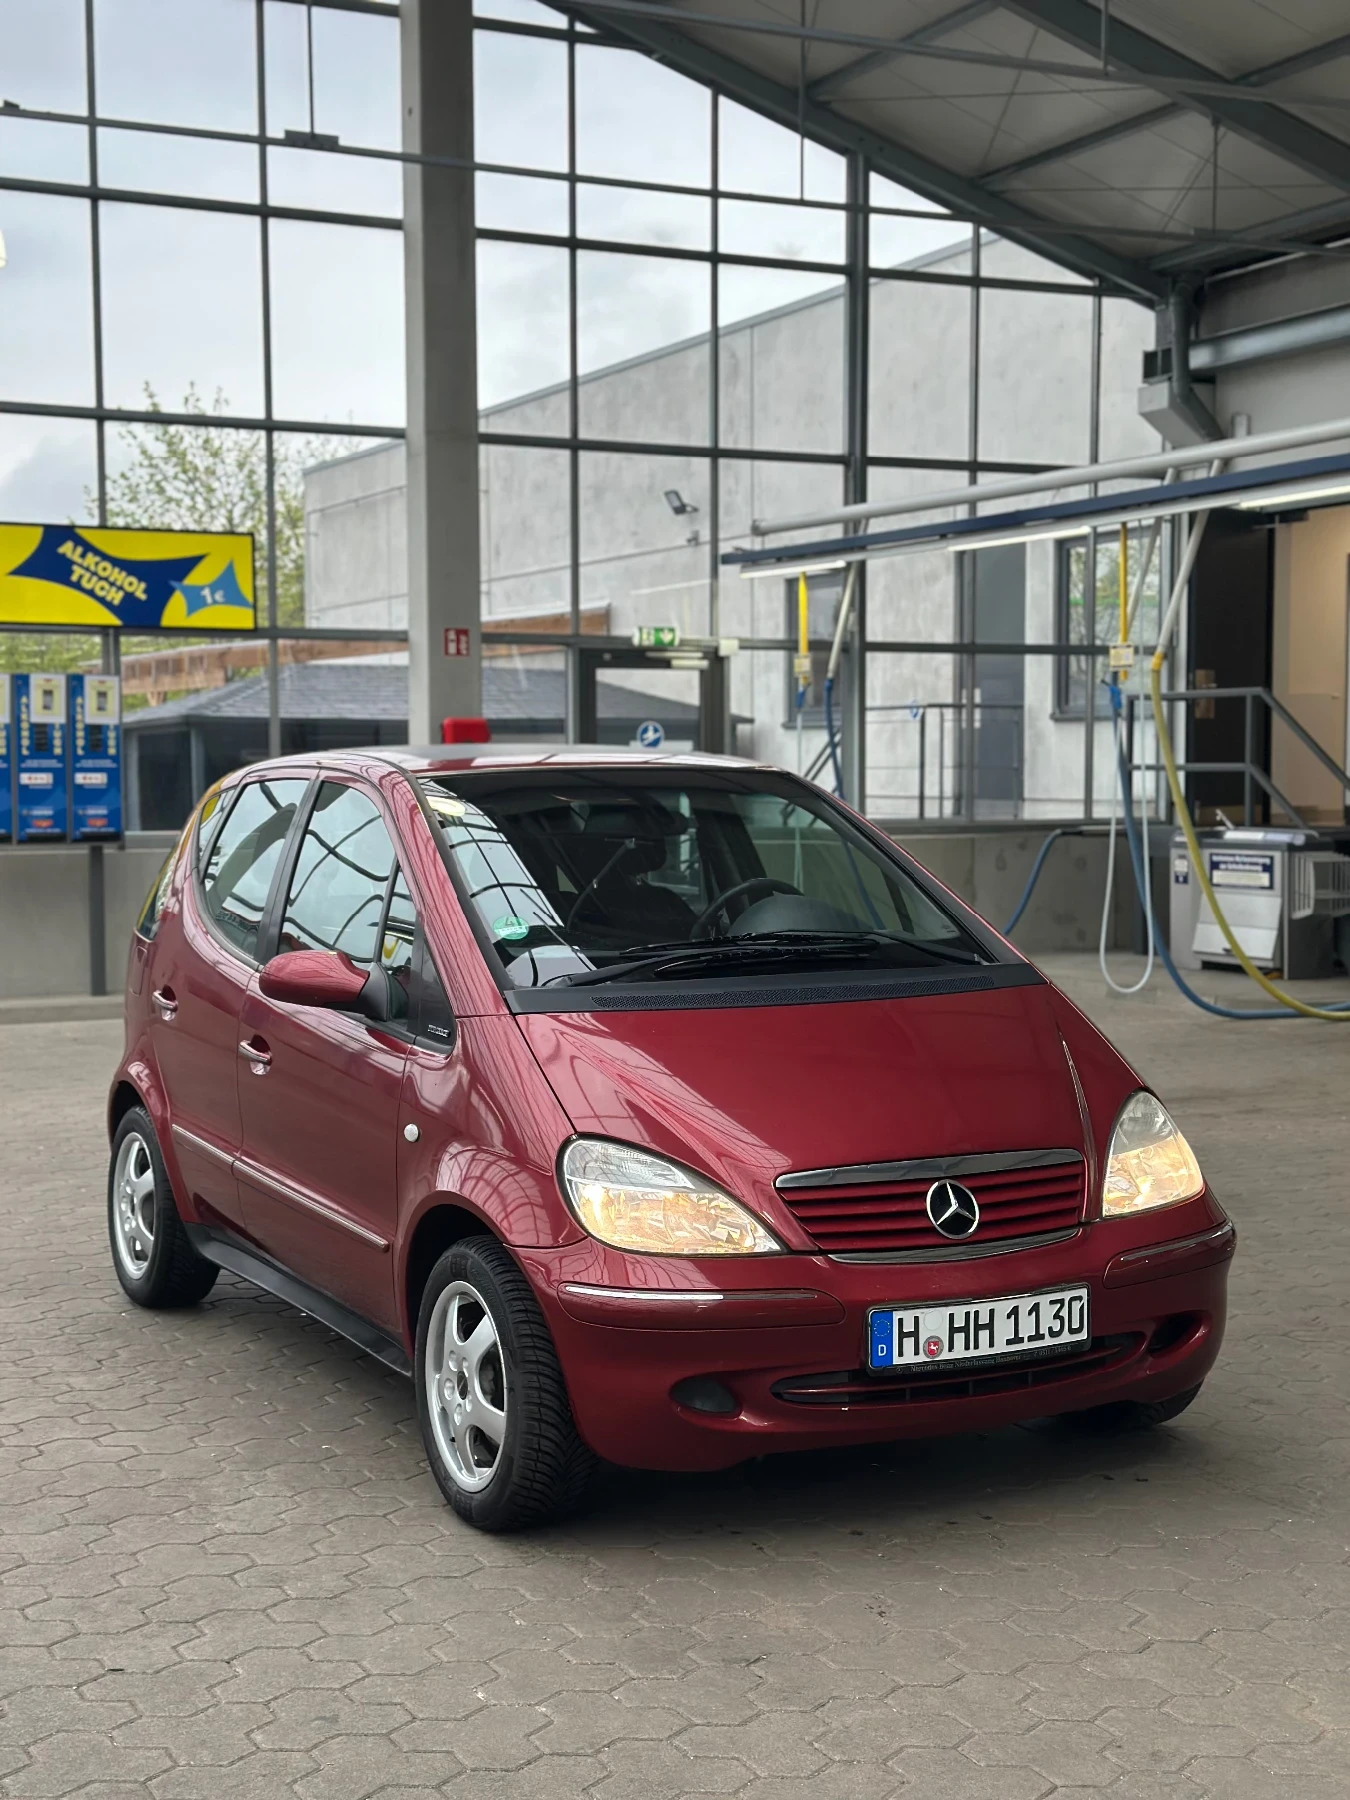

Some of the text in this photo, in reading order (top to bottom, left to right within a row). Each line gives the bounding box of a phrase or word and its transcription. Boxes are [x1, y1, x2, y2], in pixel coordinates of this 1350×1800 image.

[57, 540, 148, 601] ALKOHOL
[70, 564, 126, 606] TUCH
[200, 586, 225, 605] 1€
[897, 1295, 1085, 1358] H HH 1130
[878, 1344, 887, 1357] D
